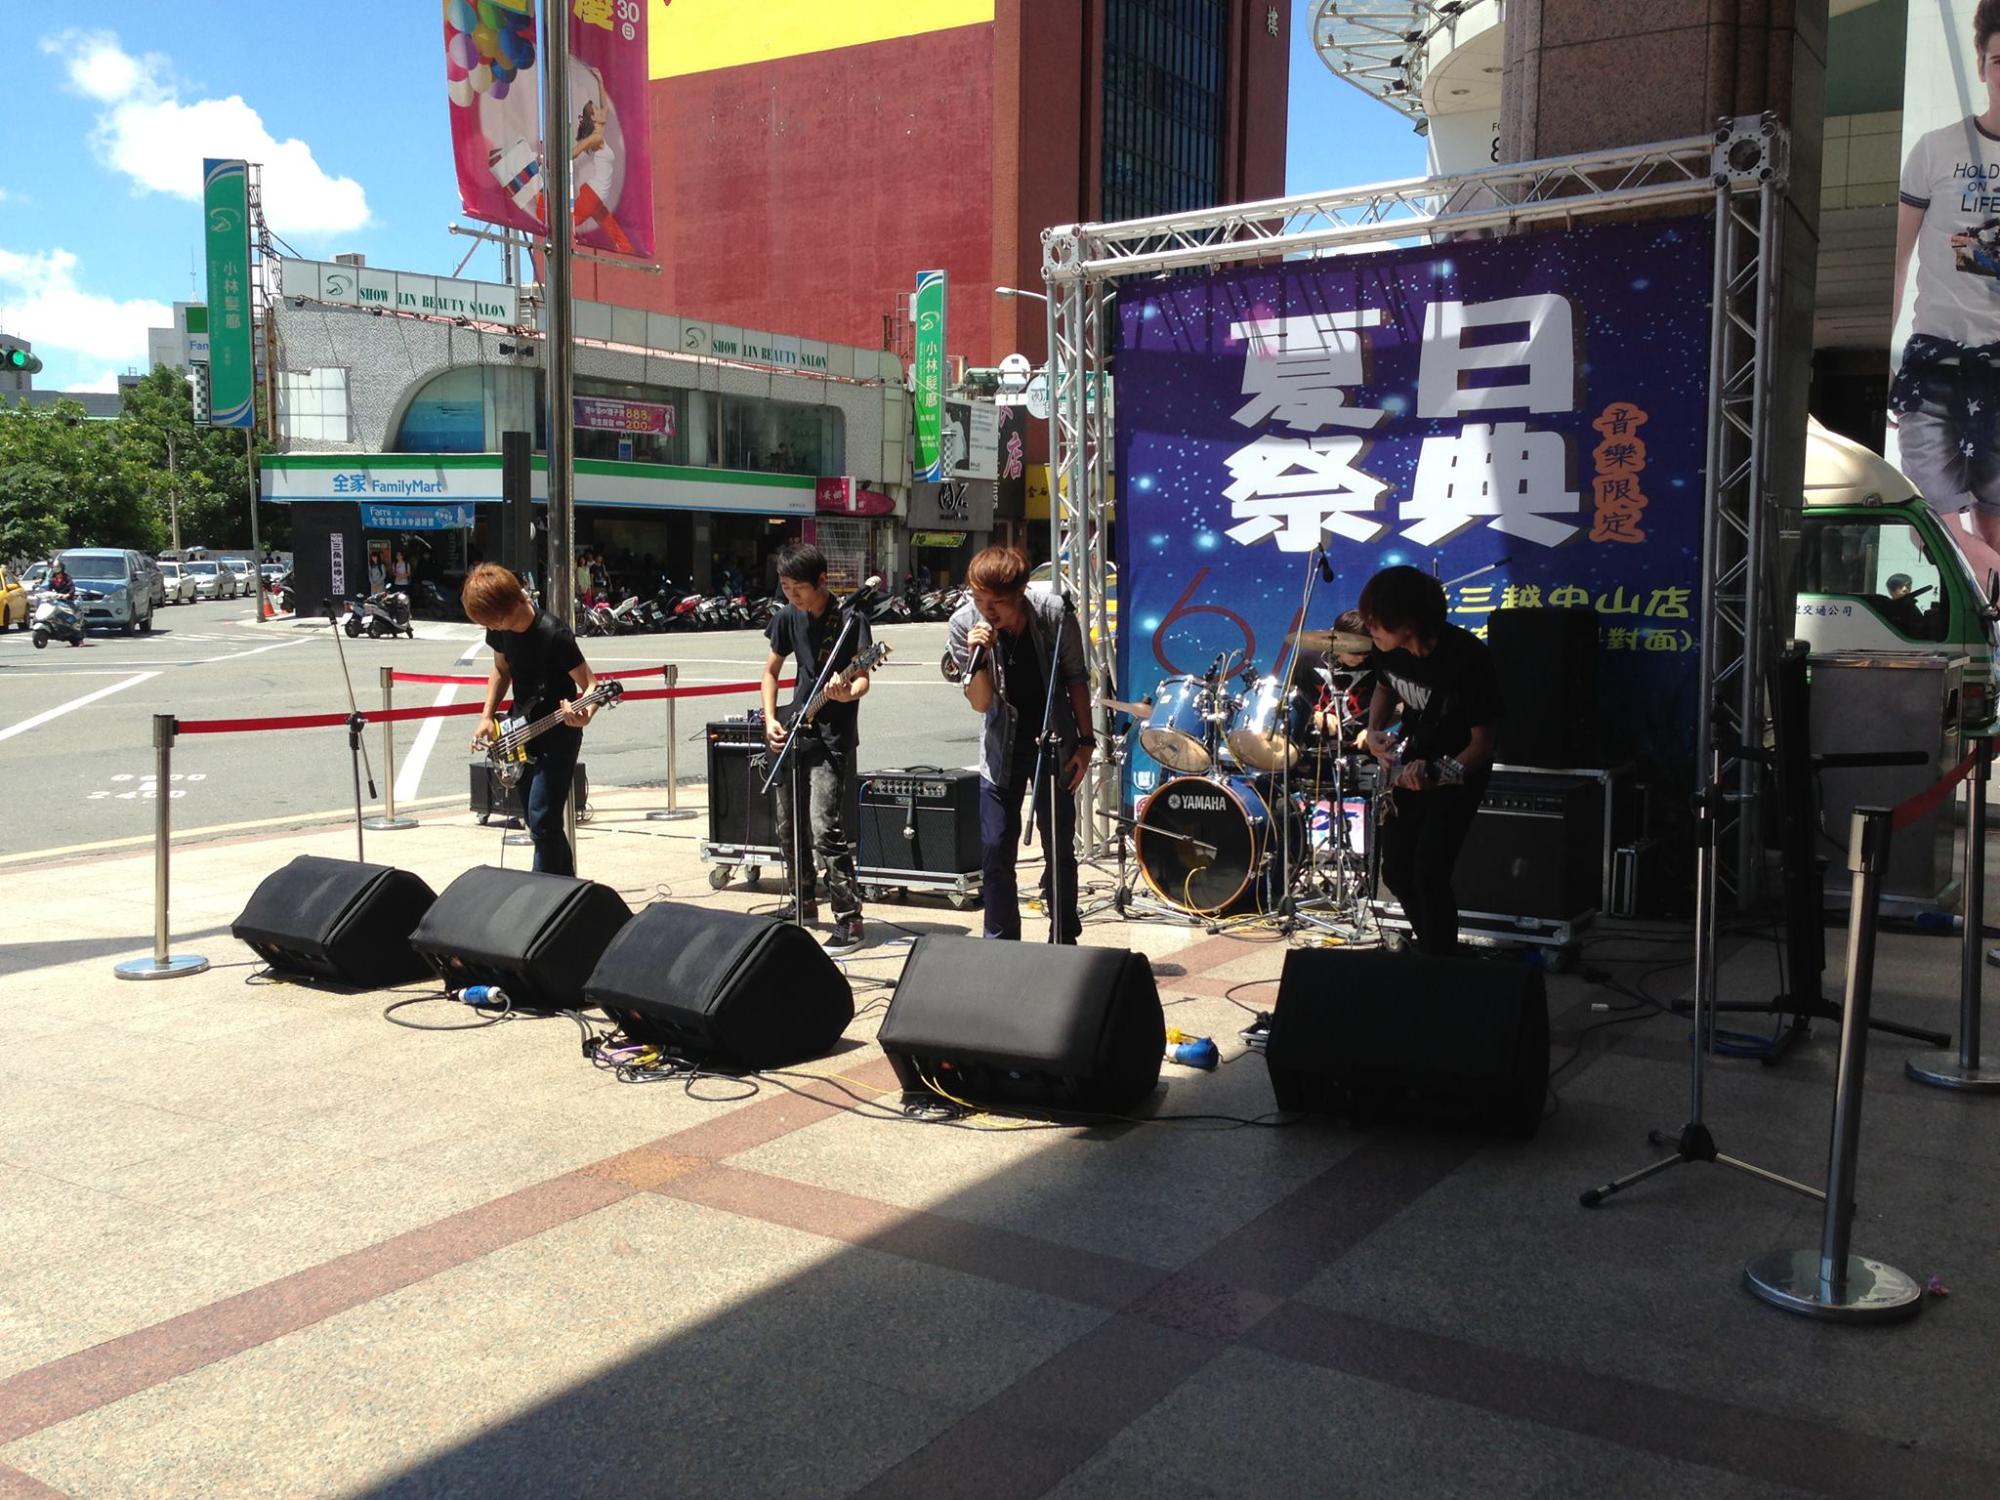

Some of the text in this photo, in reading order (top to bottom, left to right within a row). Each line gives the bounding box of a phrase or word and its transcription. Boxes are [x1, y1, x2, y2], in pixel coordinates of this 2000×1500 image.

[1953, 163, 2000, 179] HOLD
[1968, 181, 1987, 192] ON
[1961, 194, 2000, 213] LIFE
[359, 287, 506, 318] SHOW LIN BEAUTY SALON
[712, 340, 827, 369] SHOW LIN BEAUTY SALON
[1230, 293, 1574, 432] 夏日
[333, 474, 443, 496] 全家 FamilyMart
[1221, 422, 1580, 552] 祭典
[1600, 406, 1640, 539] 音樂限定
[1443, 584, 1692, 617] 三越中山店
[1181, 795, 1227, 811] YAMAHA
